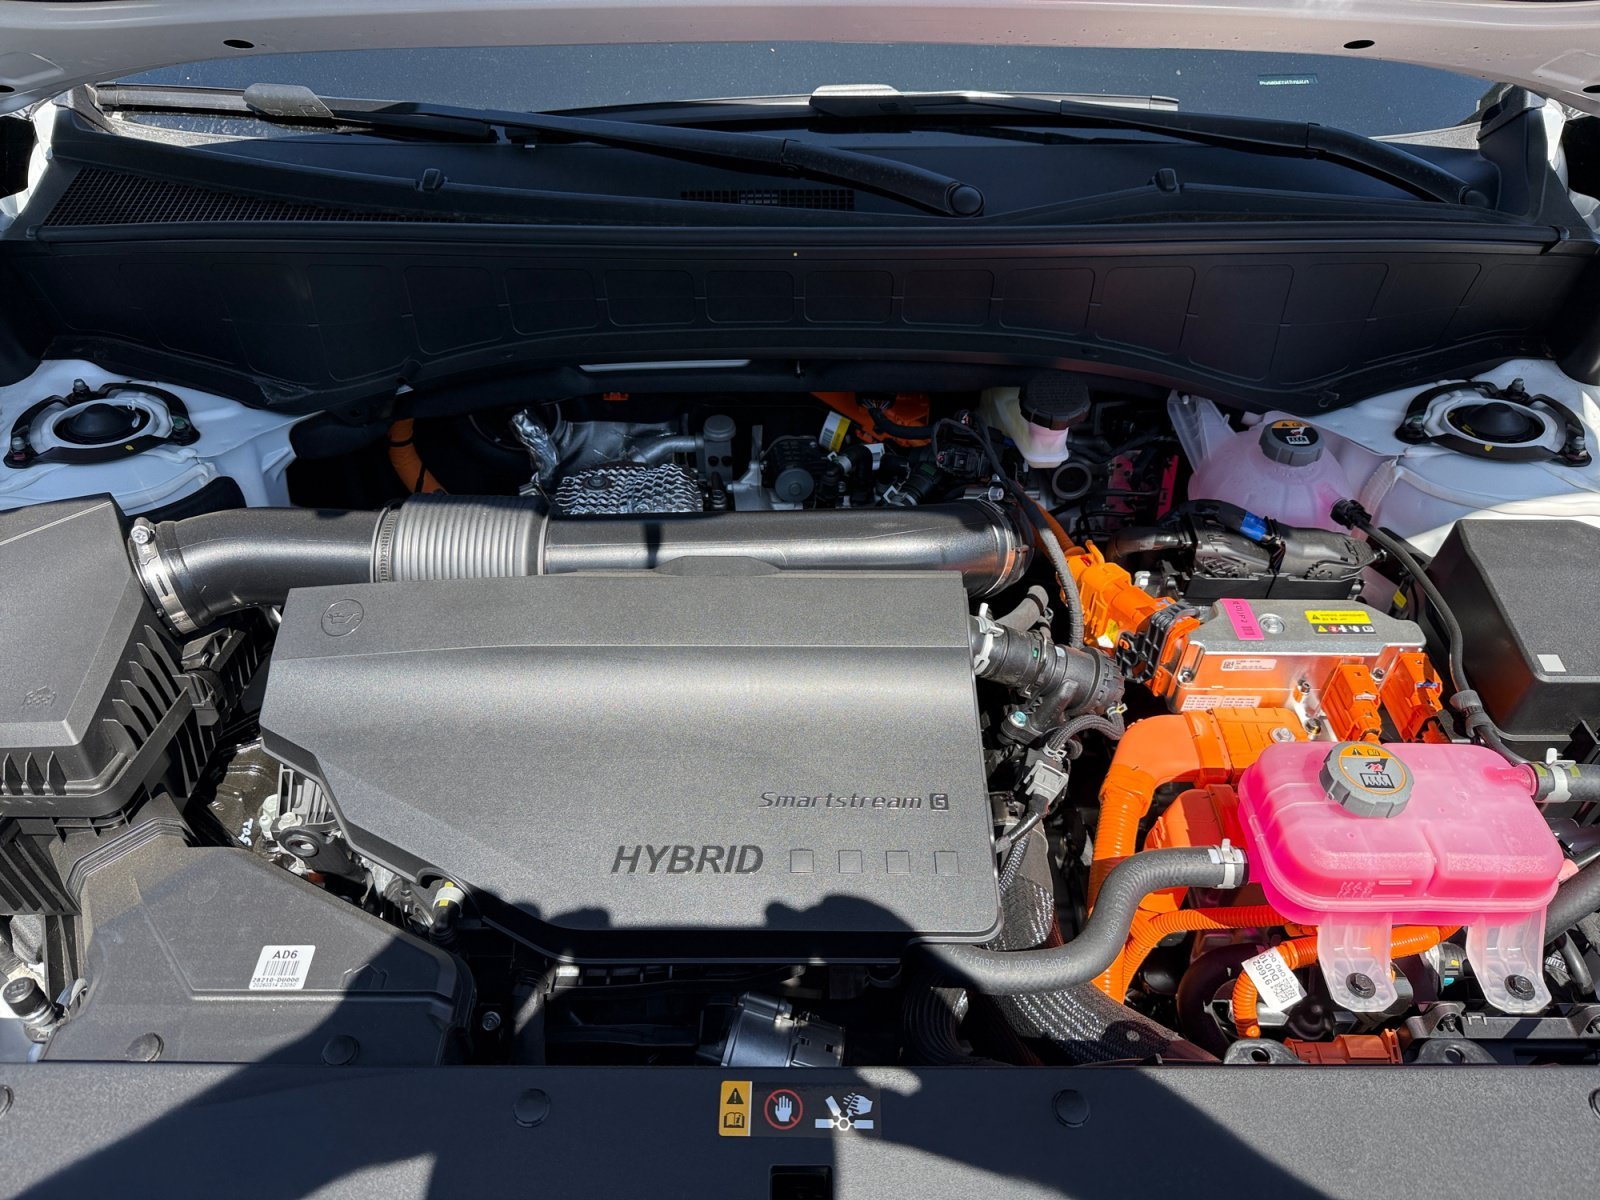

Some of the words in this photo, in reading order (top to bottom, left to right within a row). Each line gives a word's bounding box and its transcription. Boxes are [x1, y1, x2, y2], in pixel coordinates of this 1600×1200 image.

[758, 791, 922, 809] Smartstream
[930, 793, 949, 810] G
[611, 844, 764, 874] HYBRID
[272, 950, 299, 959] AD6
[1259, 953, 1280, 981] DU010
[1252, 959, 1273, 986] 91662
